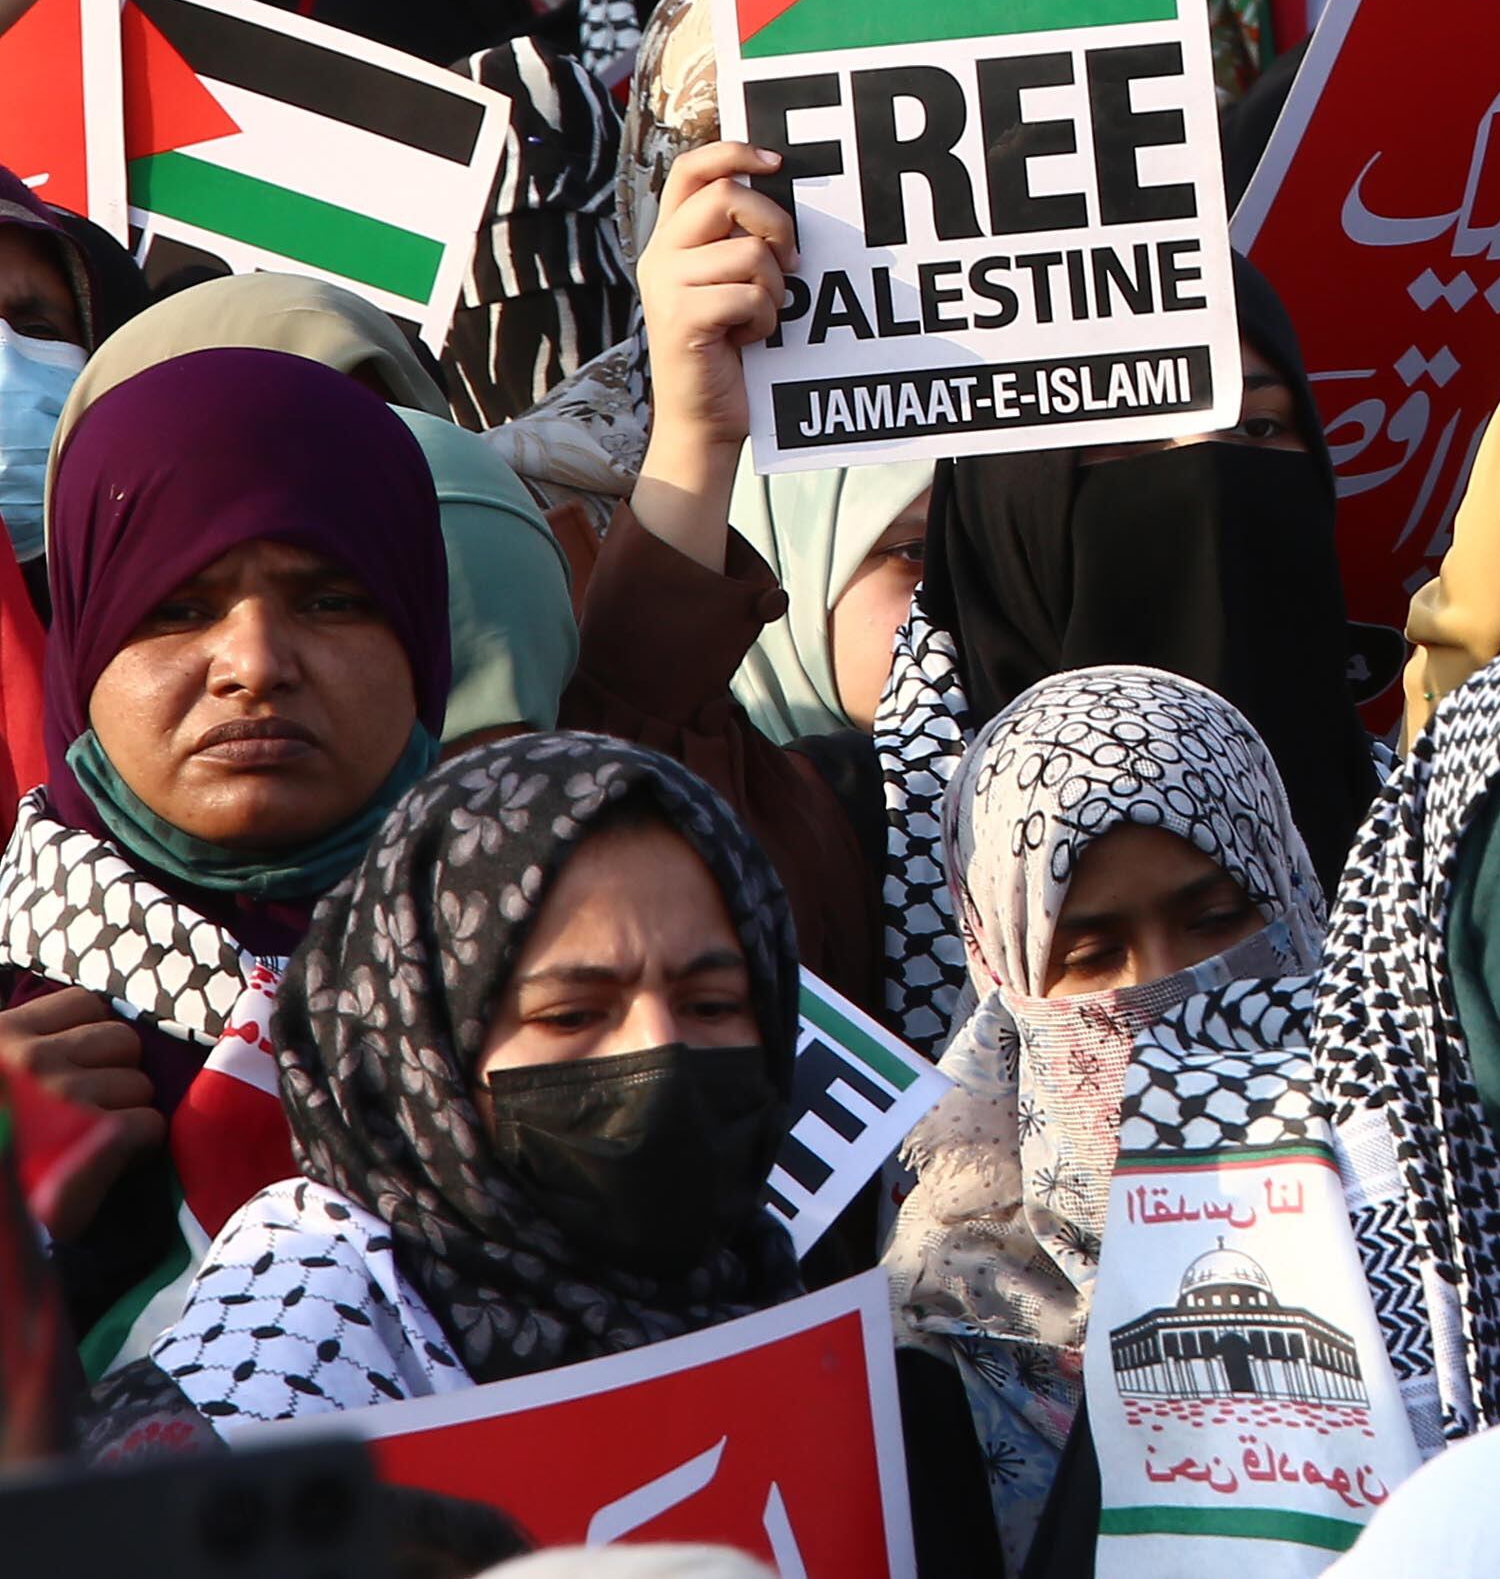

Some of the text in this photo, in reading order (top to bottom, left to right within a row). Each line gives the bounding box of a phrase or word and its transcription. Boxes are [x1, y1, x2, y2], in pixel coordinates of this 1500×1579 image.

[741, 40, 1199, 255] FREE
[766, 238, 1209, 350] PALESTINE
[798, 357, 1192, 437] JAMAAT-E-ISLAMI
